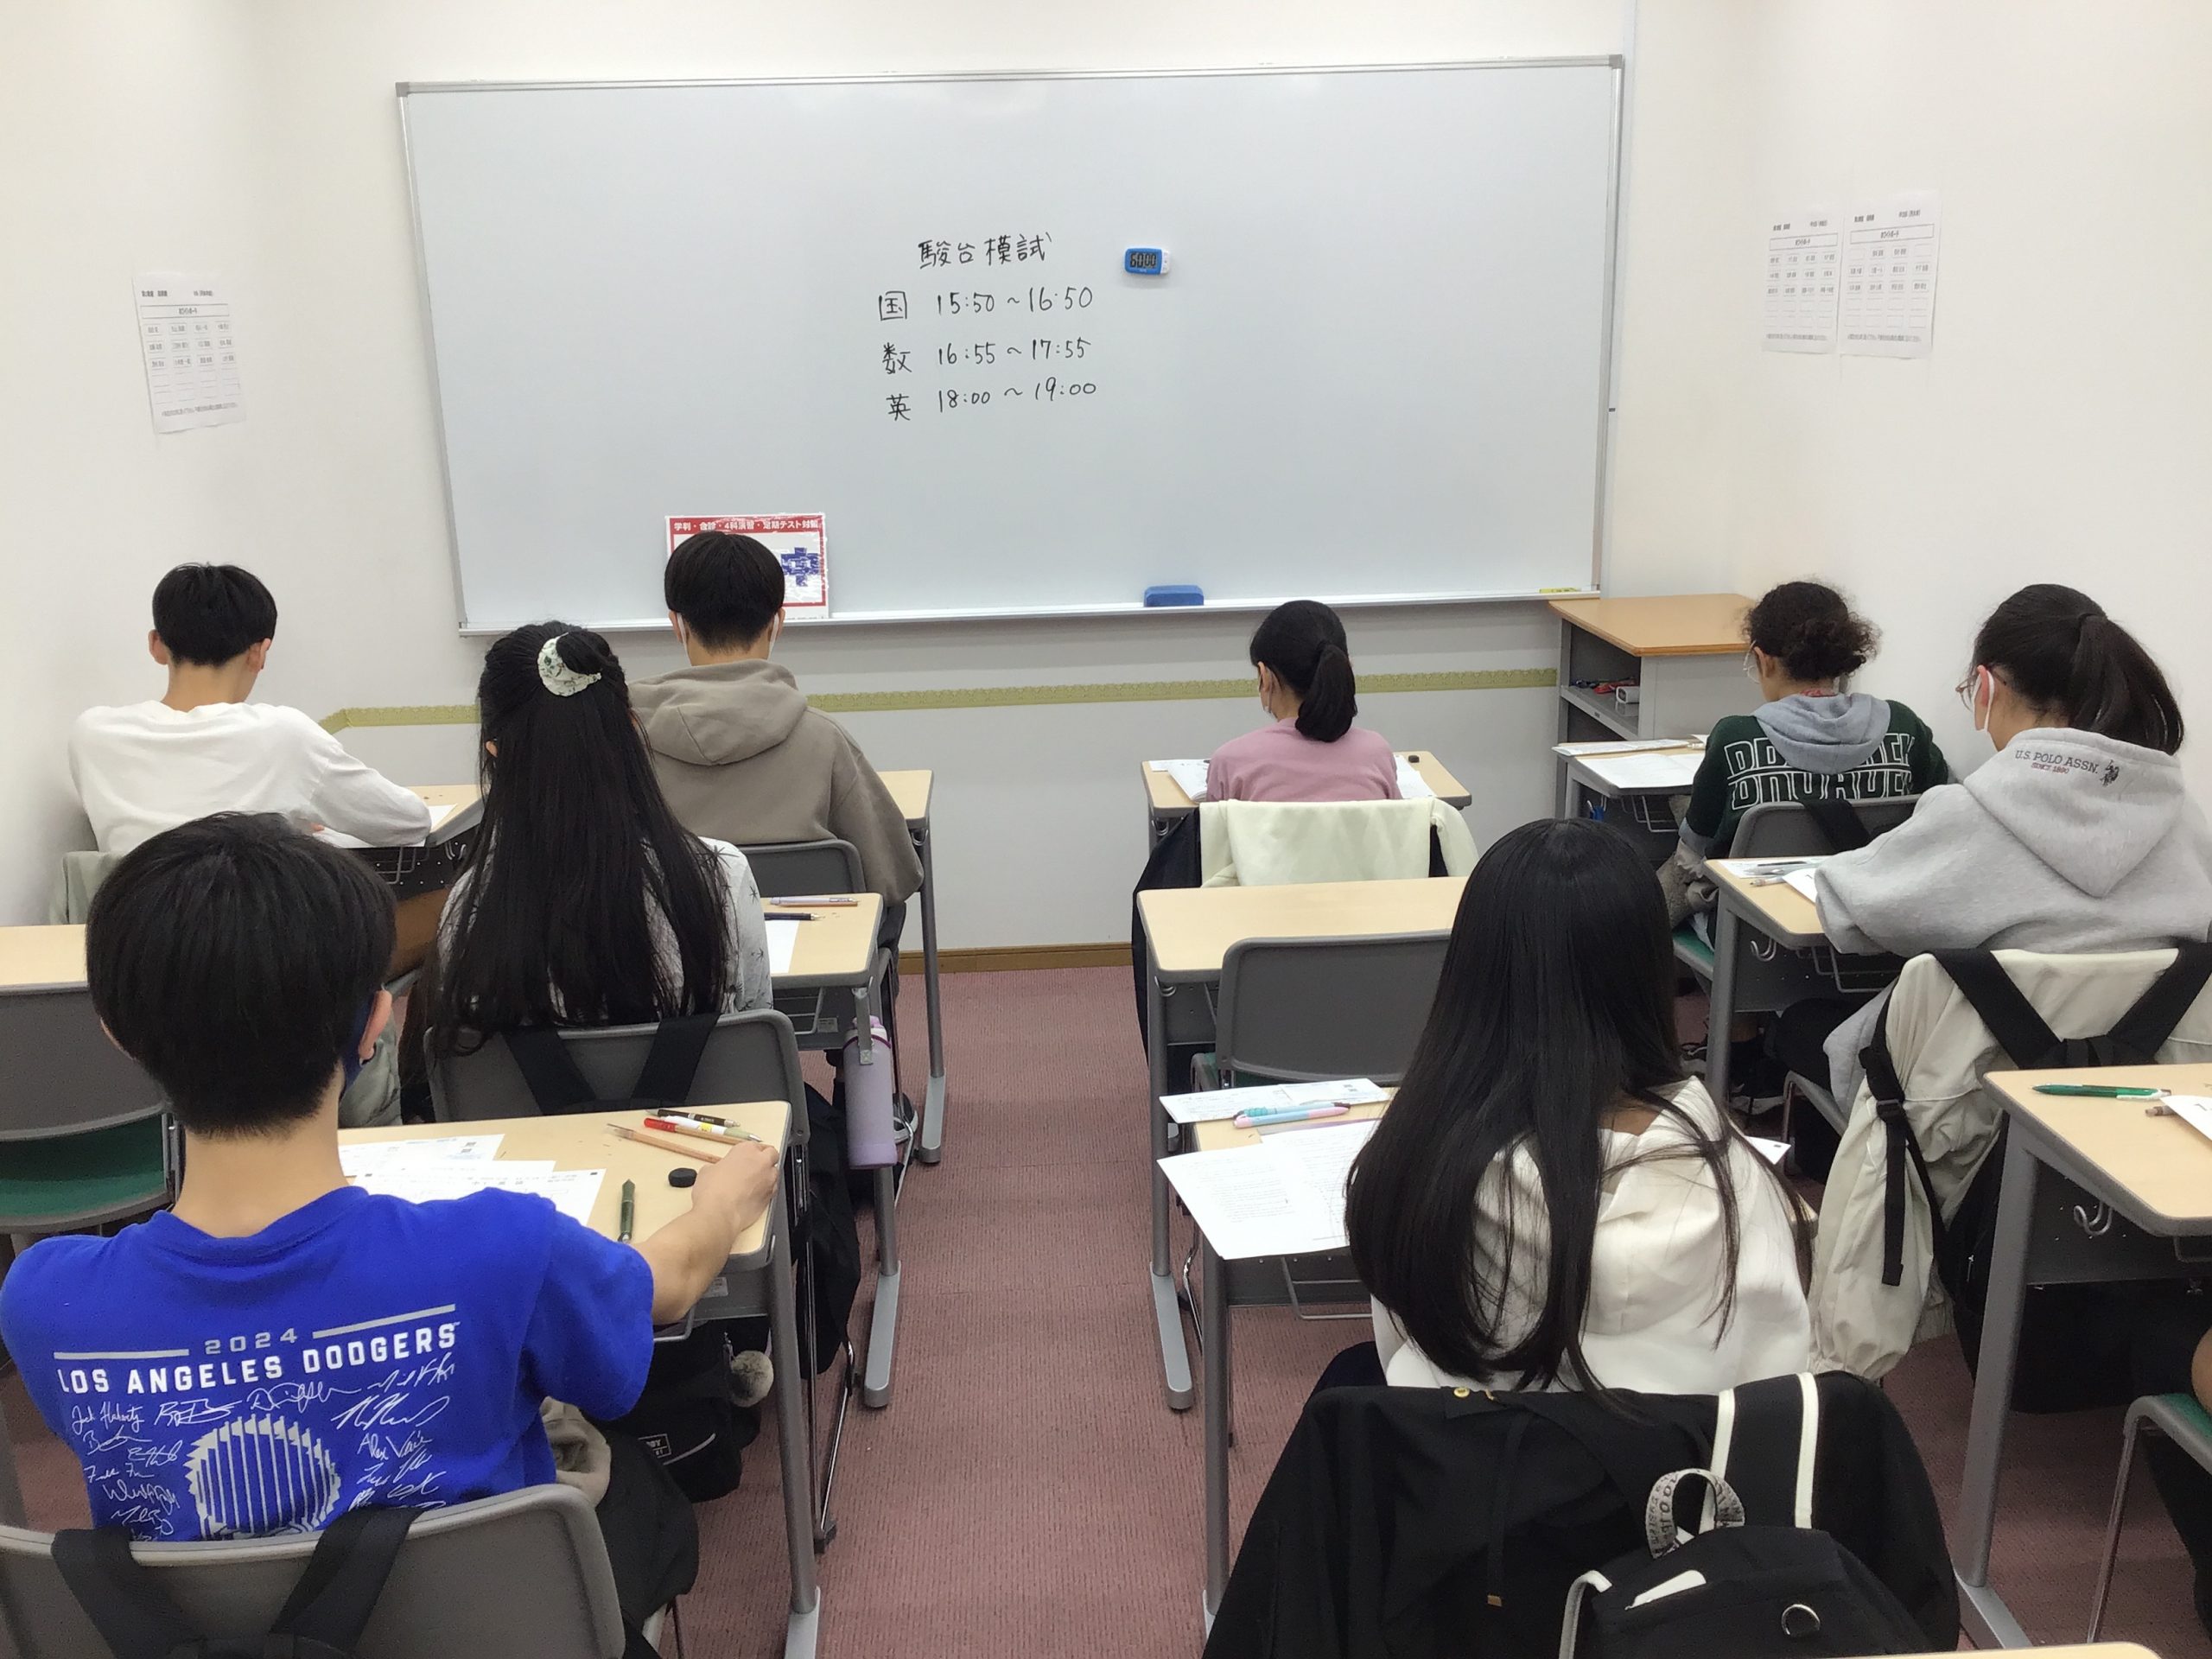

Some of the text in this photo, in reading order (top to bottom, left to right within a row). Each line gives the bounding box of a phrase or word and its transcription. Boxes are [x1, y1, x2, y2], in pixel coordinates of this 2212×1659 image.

[879, 290, 908, 321] 国
[882, 342, 912, 374] 数
[886, 393, 911, 421] 英
[2015, 750, 2100, 774] U.S. POLO ASSN.
[204, 1327, 298, 1355] 2024
[57, 1368, 110, 1395] LOS
[126, 1355, 283, 1395] ANGELES
[302, 1322, 456, 1375] DODGERS
